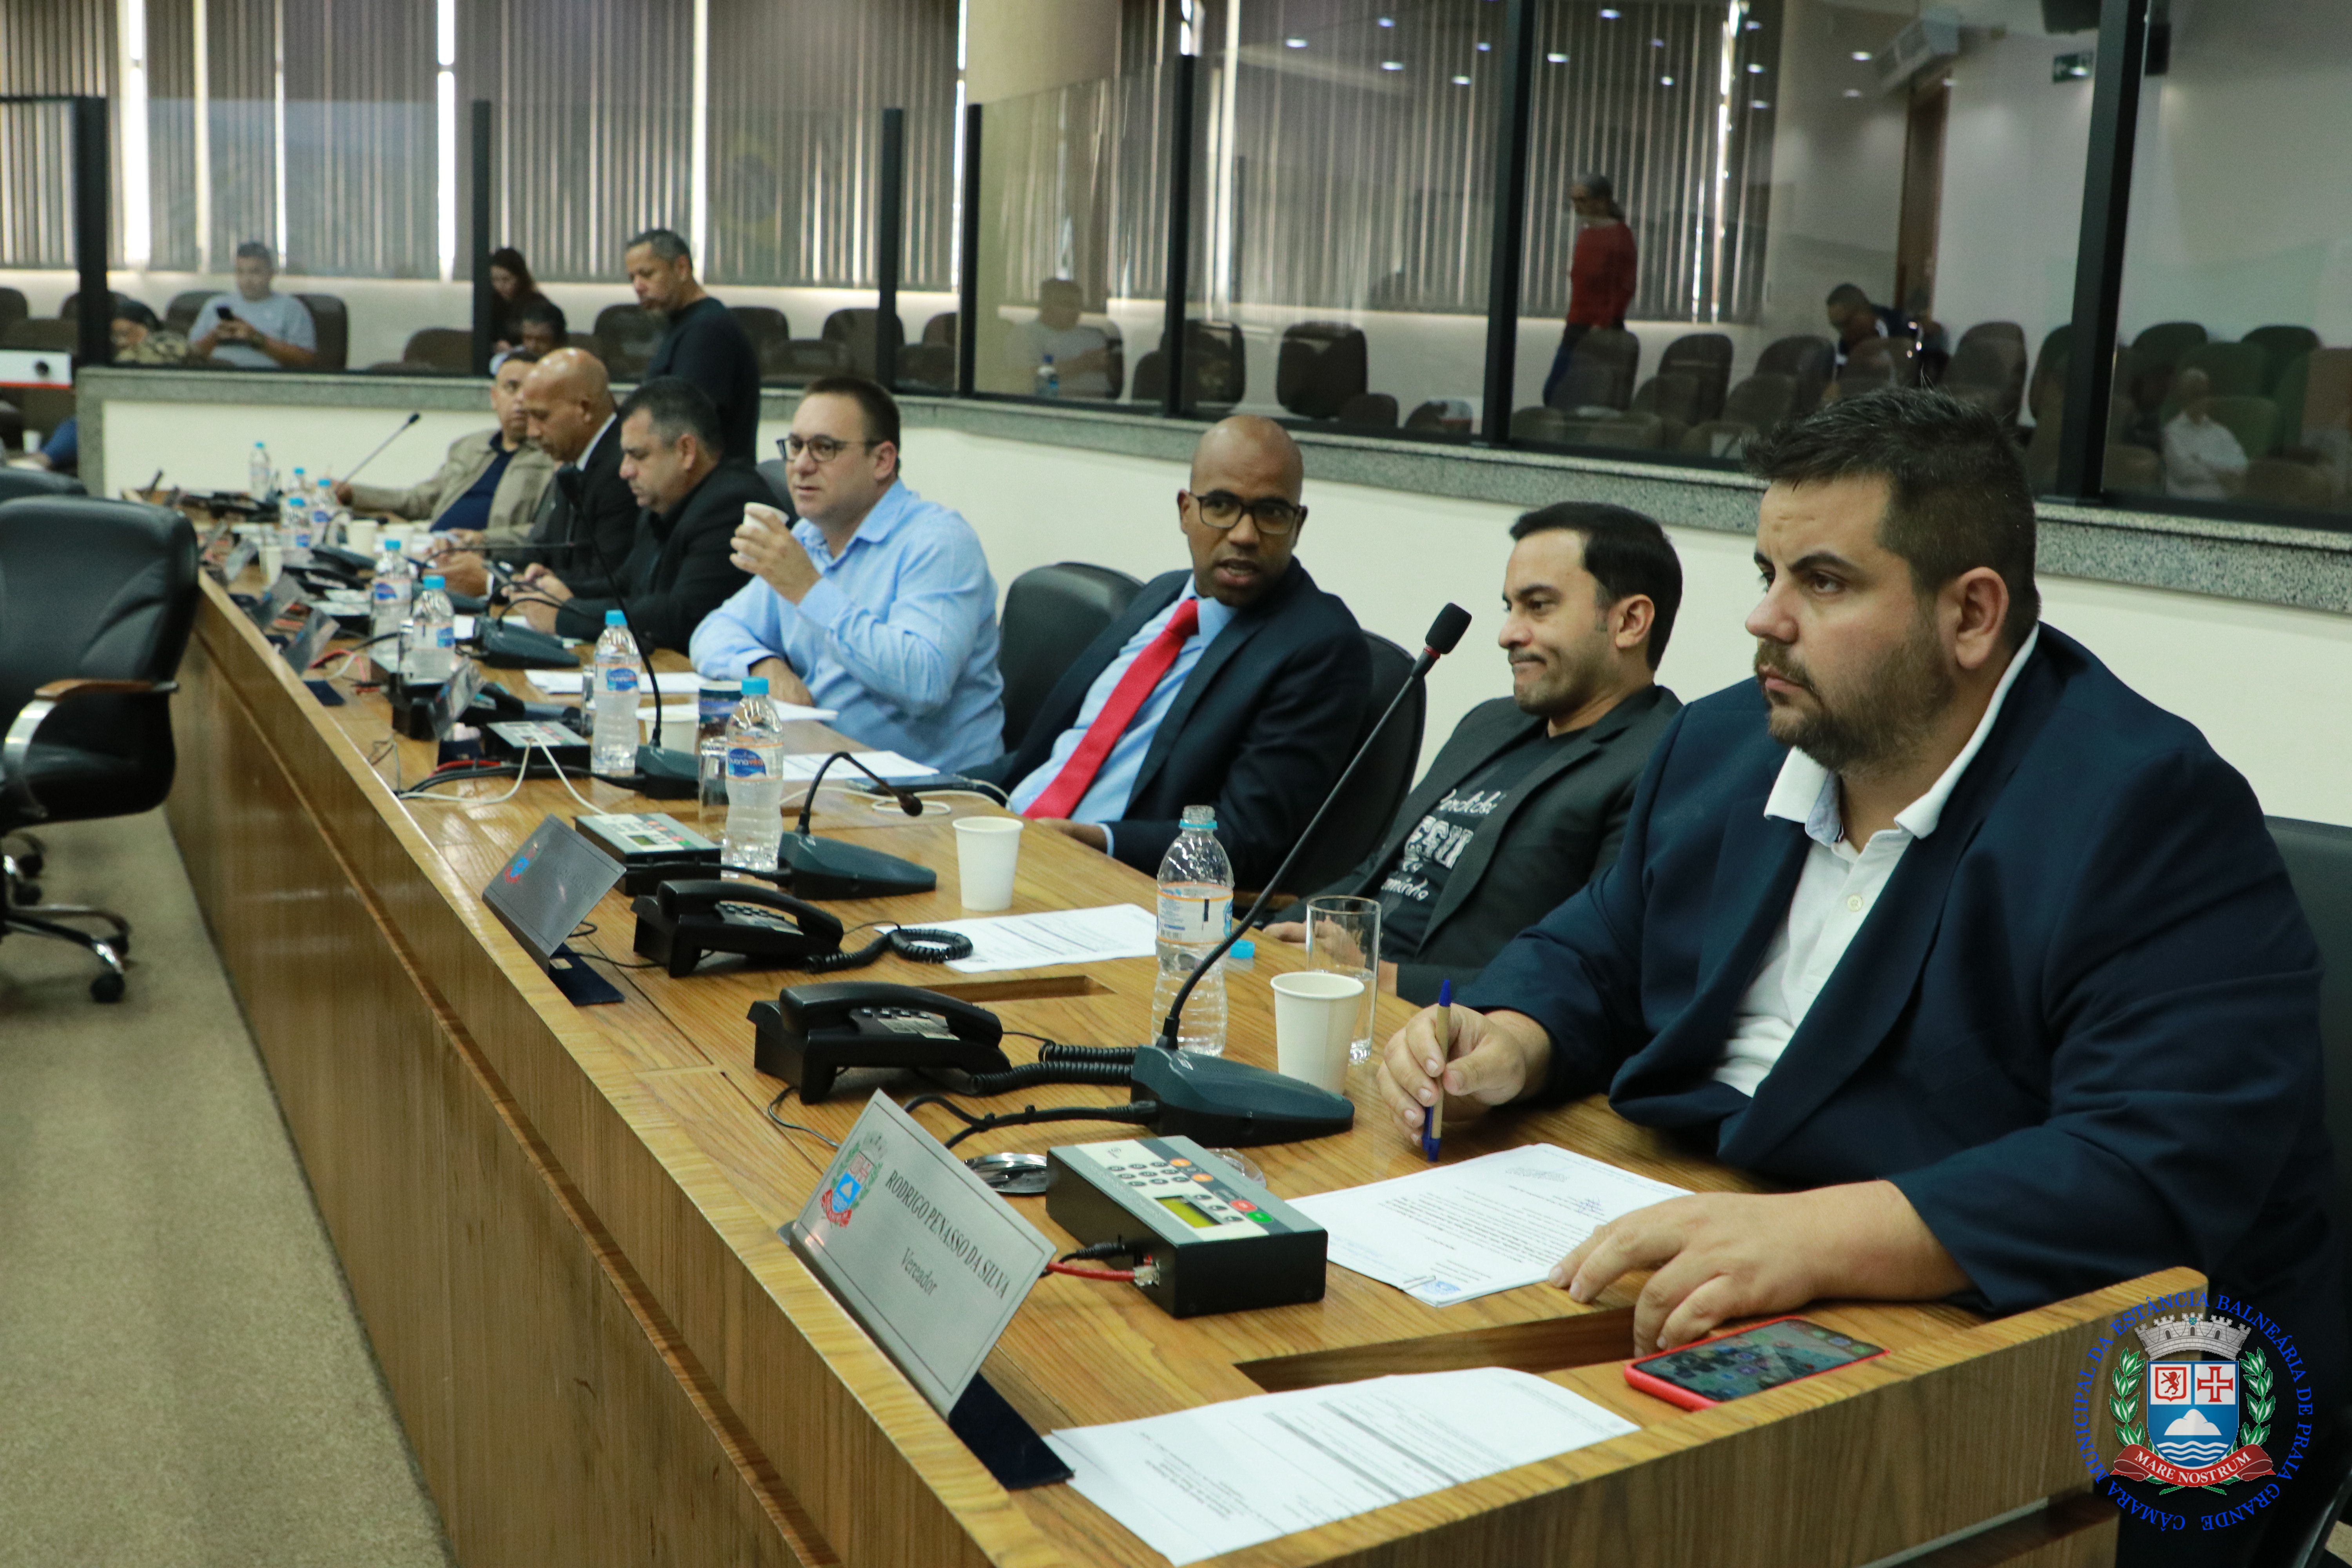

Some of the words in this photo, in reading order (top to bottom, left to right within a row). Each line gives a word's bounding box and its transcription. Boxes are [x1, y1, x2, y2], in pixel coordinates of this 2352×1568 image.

[885, 1169, 930, 1220] RODRIGO
[924, 1207, 970, 1258] PENASSO
[964, 1245, 984, 1273] DA
[978, 1259, 1011, 1299] SILVA
[901, 1246, 938, 1295] Vereador
